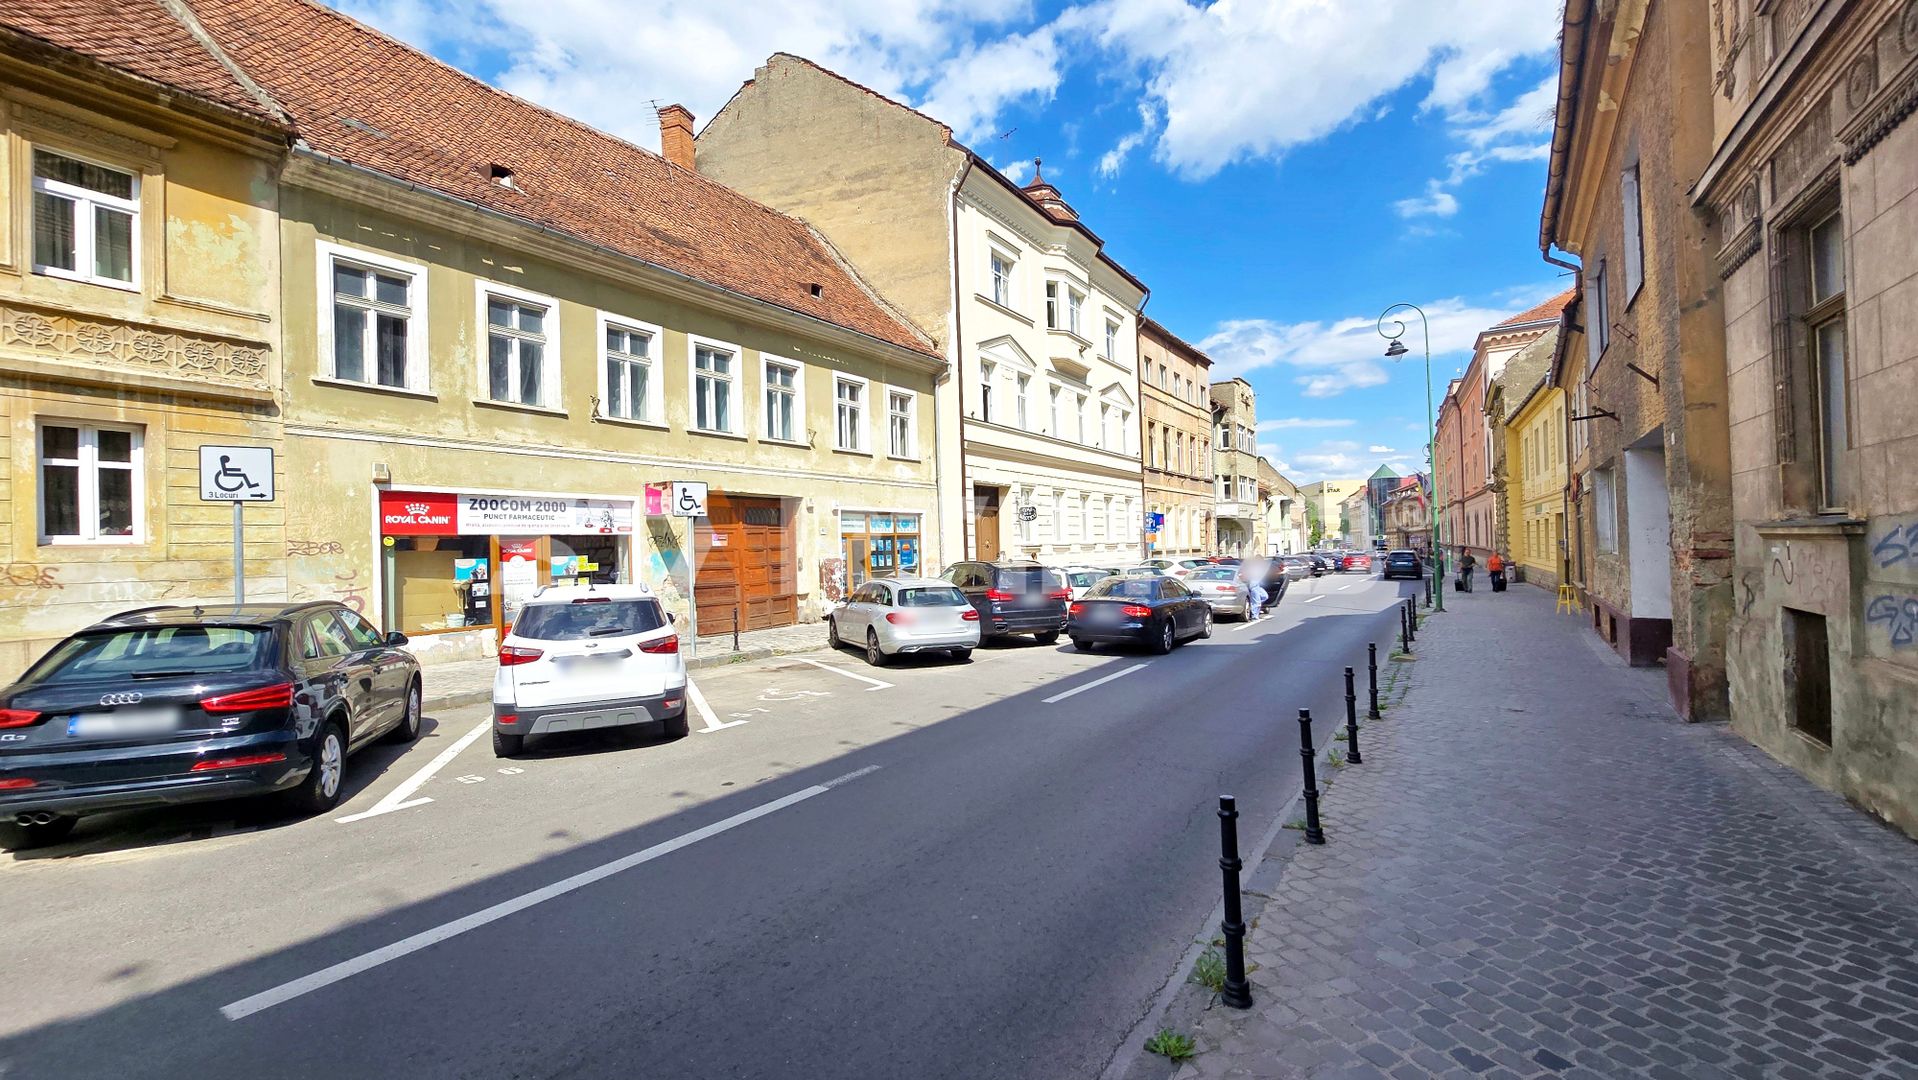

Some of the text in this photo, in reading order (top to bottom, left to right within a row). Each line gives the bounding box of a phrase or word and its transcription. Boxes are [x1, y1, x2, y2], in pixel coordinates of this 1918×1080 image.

[208, 491, 239, 499] 3 Locuri
[468, 498, 567, 513] ZOOCOM 2000
[385, 515, 449, 525] ROYAL CANIN
